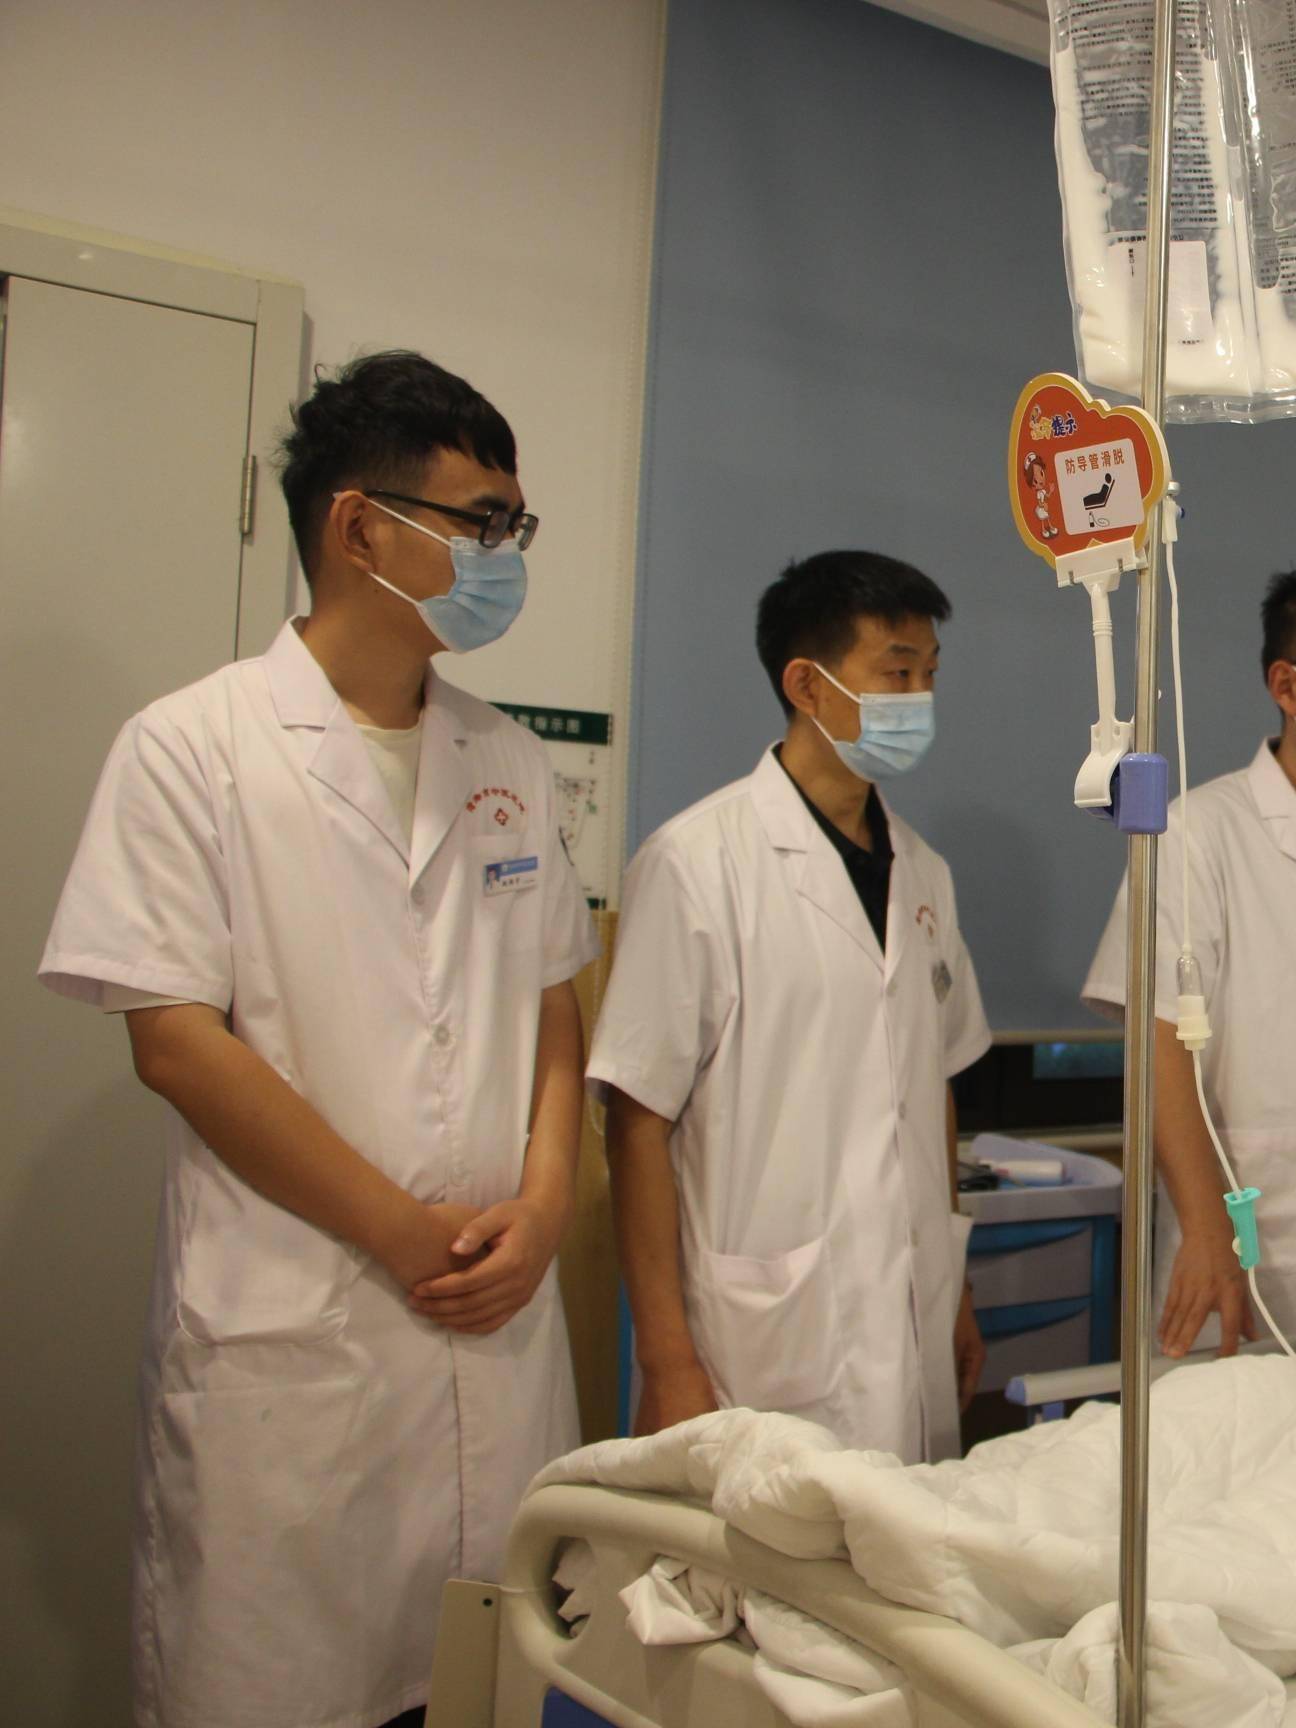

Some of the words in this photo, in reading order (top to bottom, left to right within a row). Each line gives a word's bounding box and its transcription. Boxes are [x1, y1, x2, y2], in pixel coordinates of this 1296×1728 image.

[1065, 448, 1124, 474] 防导管滑脱
